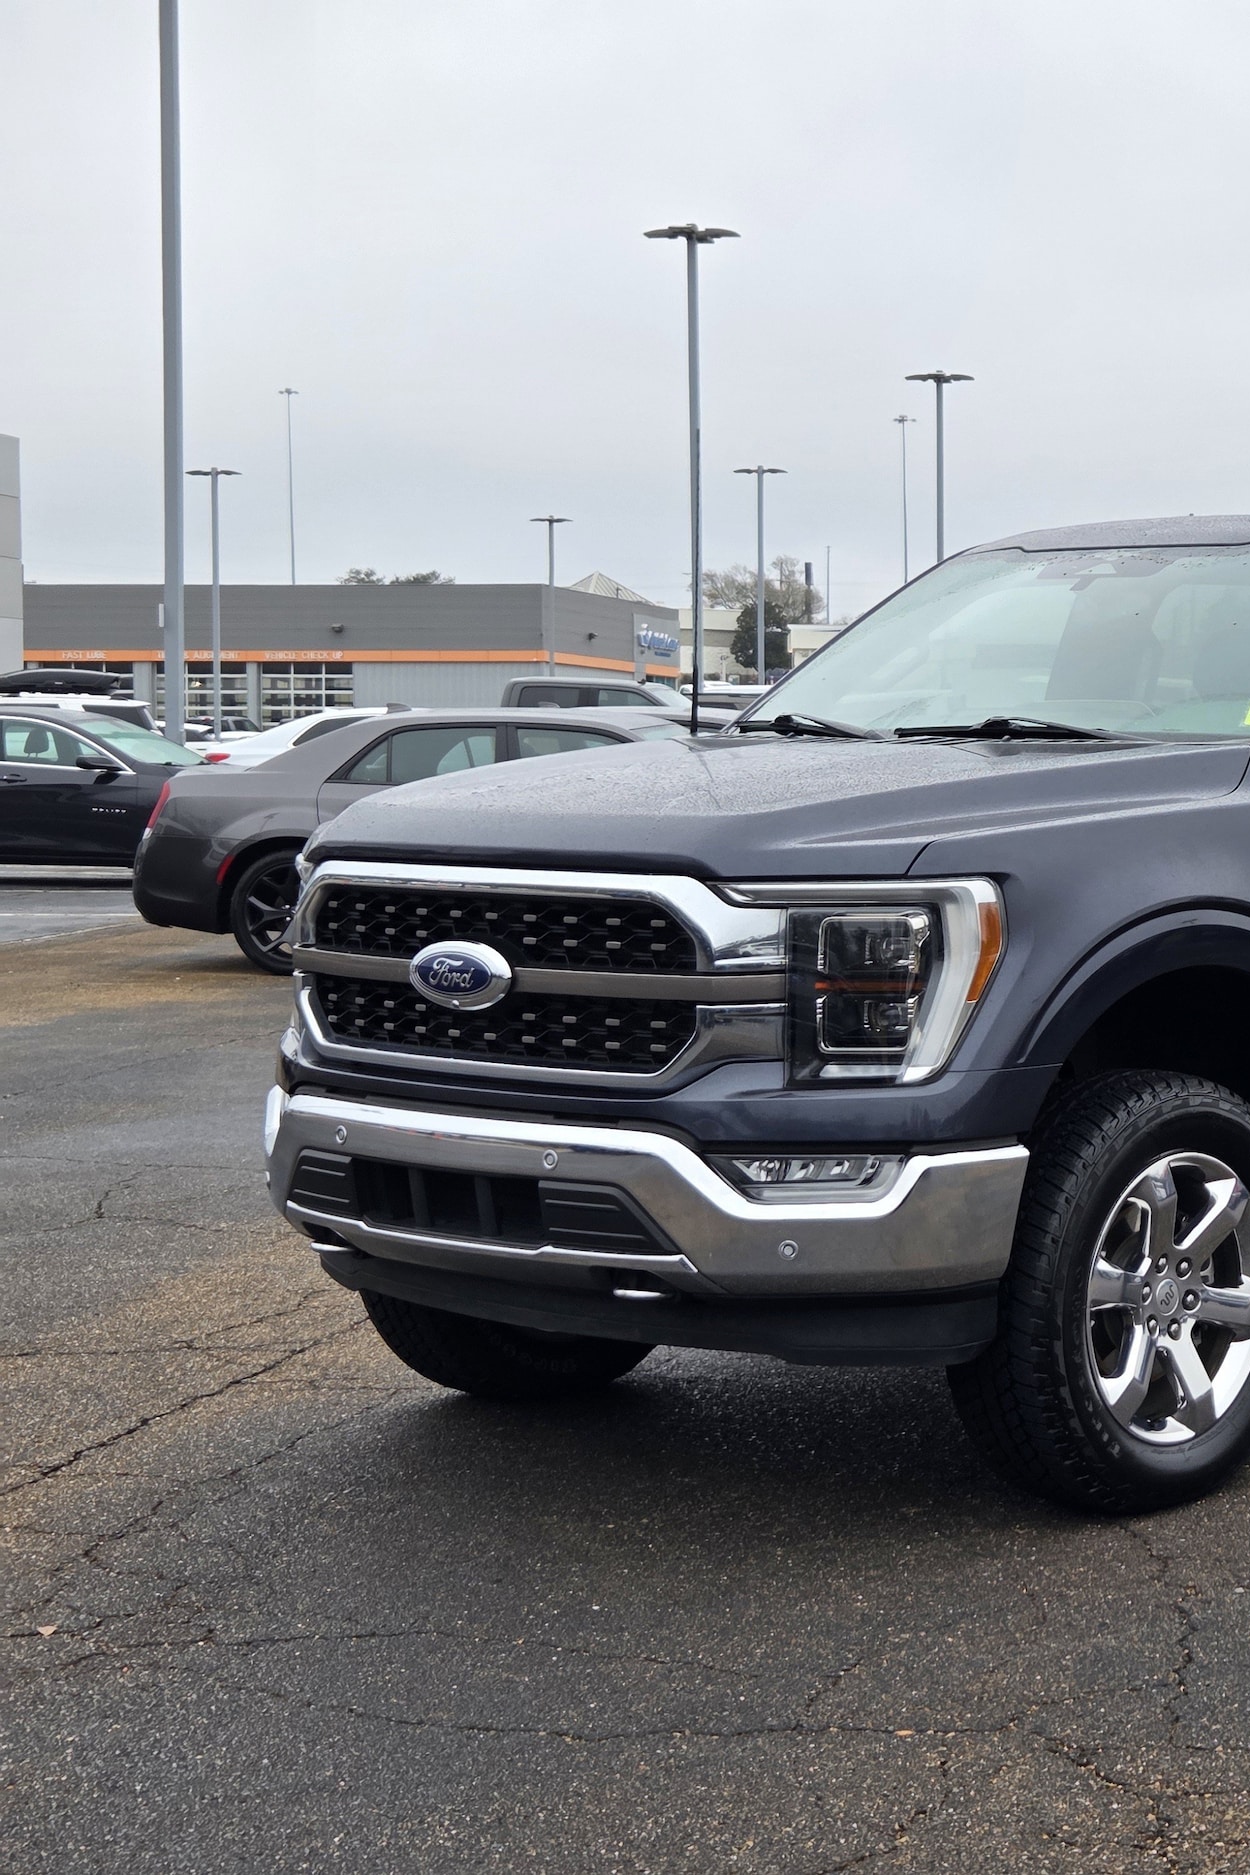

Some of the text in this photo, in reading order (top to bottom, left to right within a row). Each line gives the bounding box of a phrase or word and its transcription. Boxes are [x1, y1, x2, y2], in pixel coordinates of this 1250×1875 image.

[62, 651, 107, 659] FAST LUBE
[193, 651, 239, 659] ALIGMENT
[264, 651, 343, 659] VEHICLE CHECK UP
[428, 957, 475, 988] Ford
